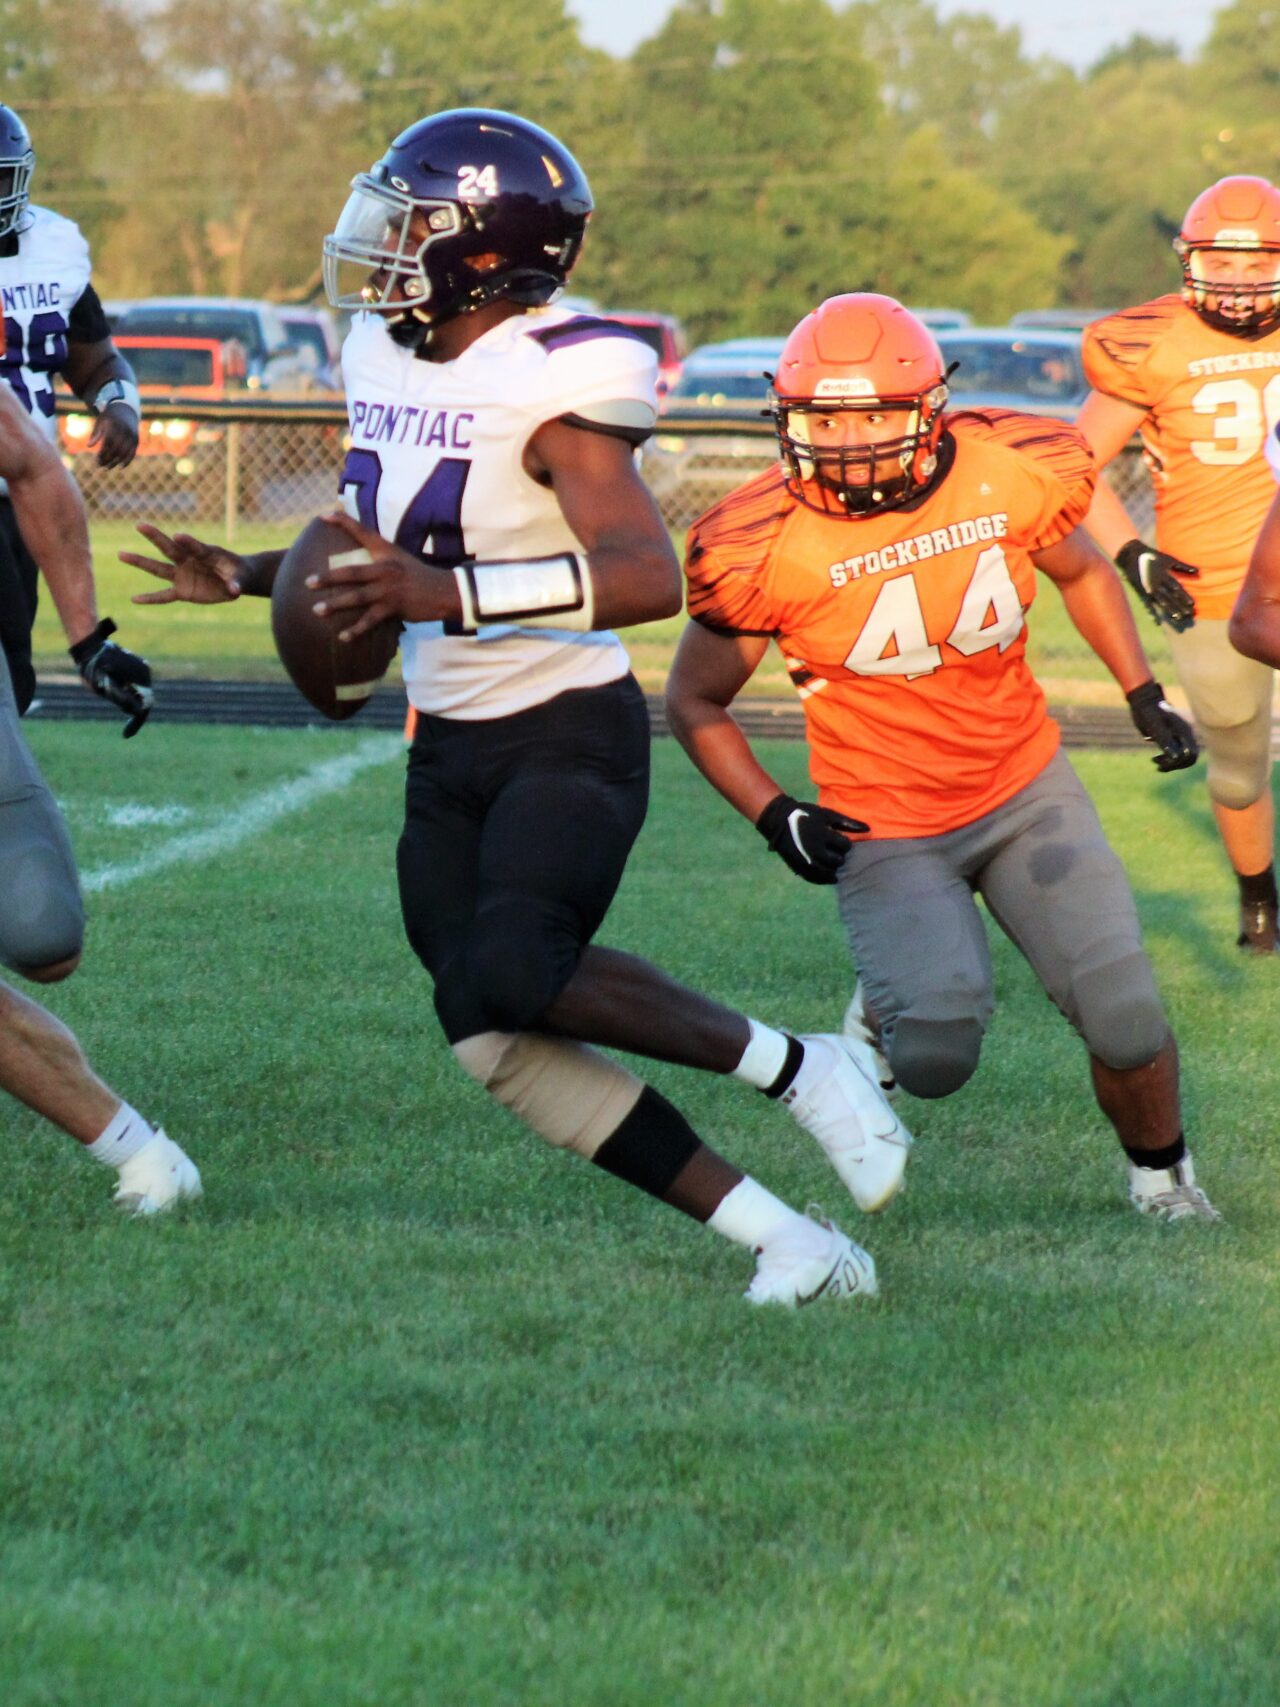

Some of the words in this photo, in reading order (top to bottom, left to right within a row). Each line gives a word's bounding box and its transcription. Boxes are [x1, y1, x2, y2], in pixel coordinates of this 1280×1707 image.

[458, 164, 499, 197] 24
[0, 281, 61, 312] NTIAC
[352, 400, 475, 450] PONTIAC
[828, 512, 1009, 588] STOCKBRIDGE
[842, 542, 1026, 682] 44
